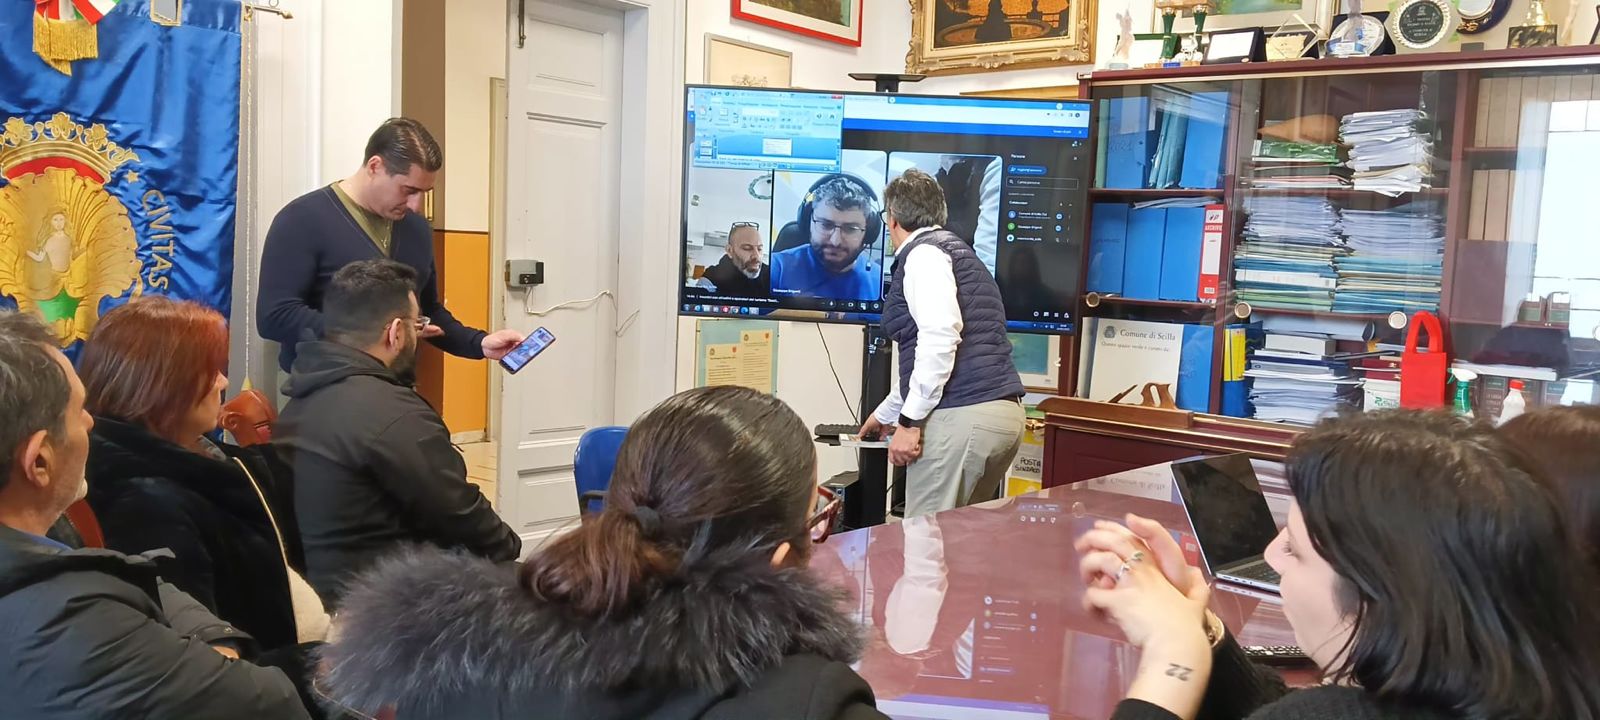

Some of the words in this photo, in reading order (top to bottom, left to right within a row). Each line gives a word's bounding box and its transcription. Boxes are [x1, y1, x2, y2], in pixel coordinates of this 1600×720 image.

[142, 189, 175, 291] CIVITAS
[1120, 329, 1147, 338] Comune
[1149, 331, 1156, 339] di
[1158, 332, 1176, 341] Scilla
[1164, 663, 1194, 682] 22
